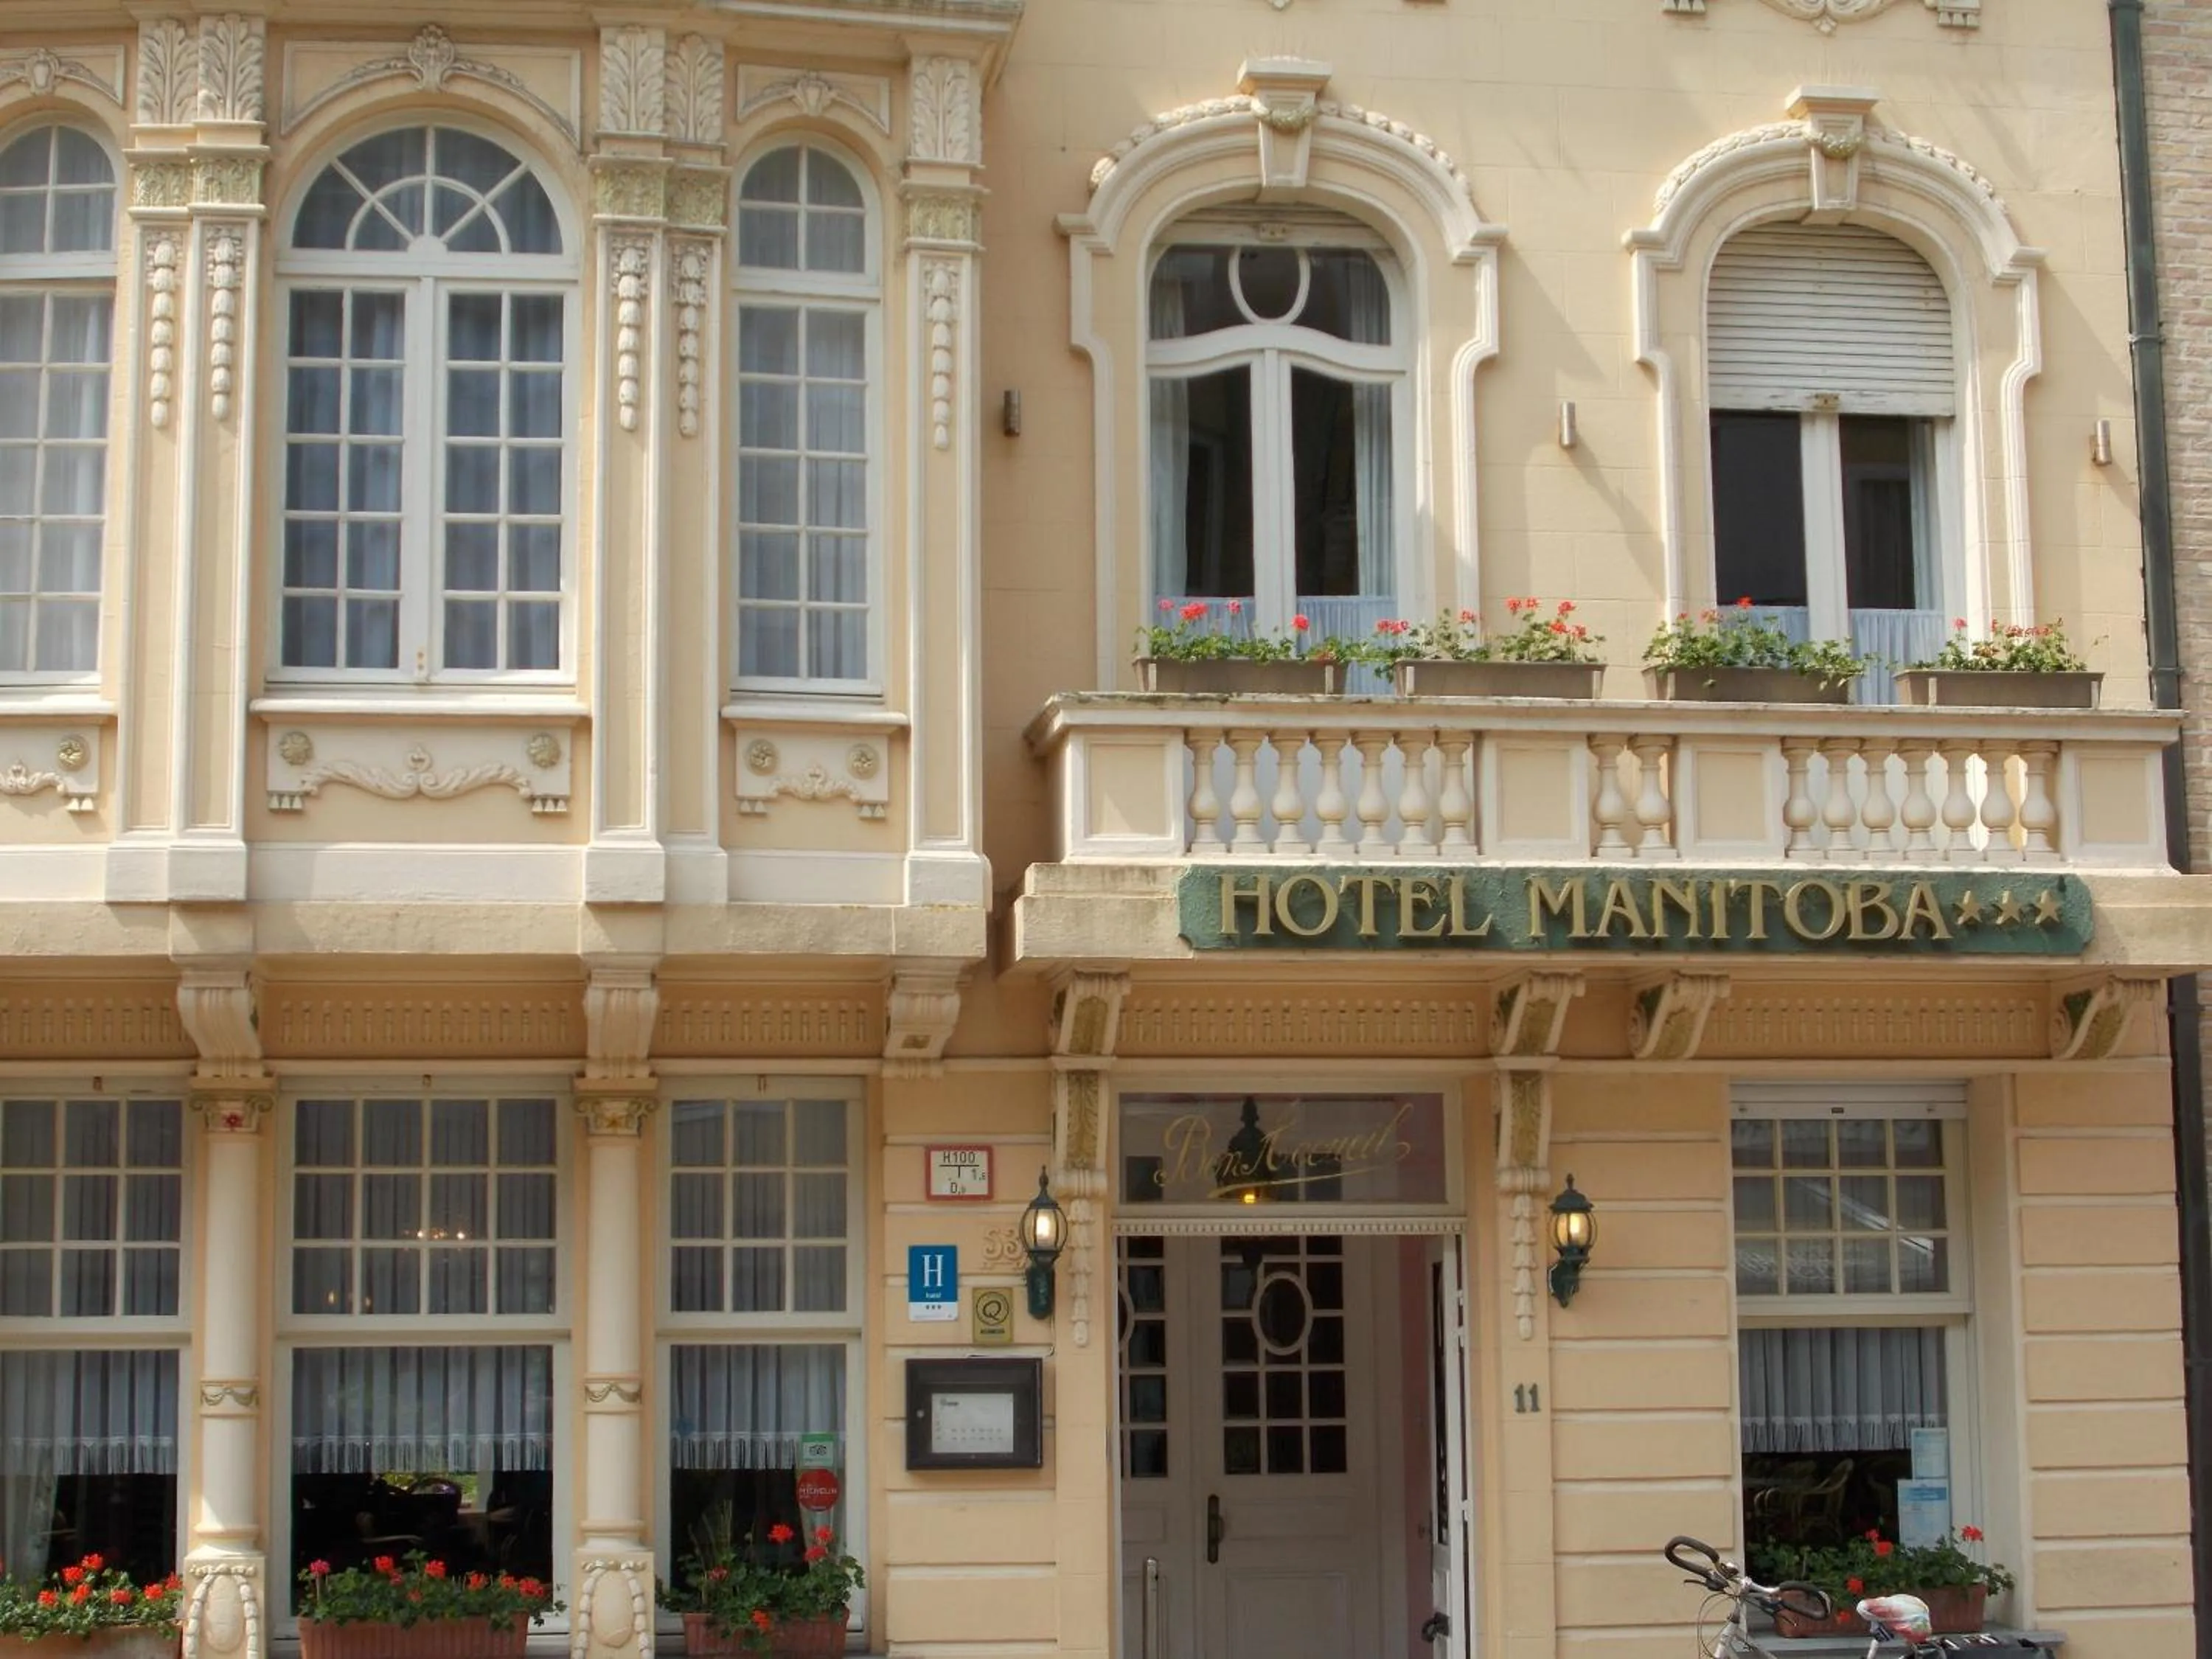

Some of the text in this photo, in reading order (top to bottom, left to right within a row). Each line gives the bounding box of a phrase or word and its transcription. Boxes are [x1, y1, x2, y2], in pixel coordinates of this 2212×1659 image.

[1218, 873, 1953, 940] HOTEL MANITOBA
[943, 1151, 975, 1164] H100
[922, 1254, 944, 1287] H
[1514, 1382, 1541, 1413] 11
